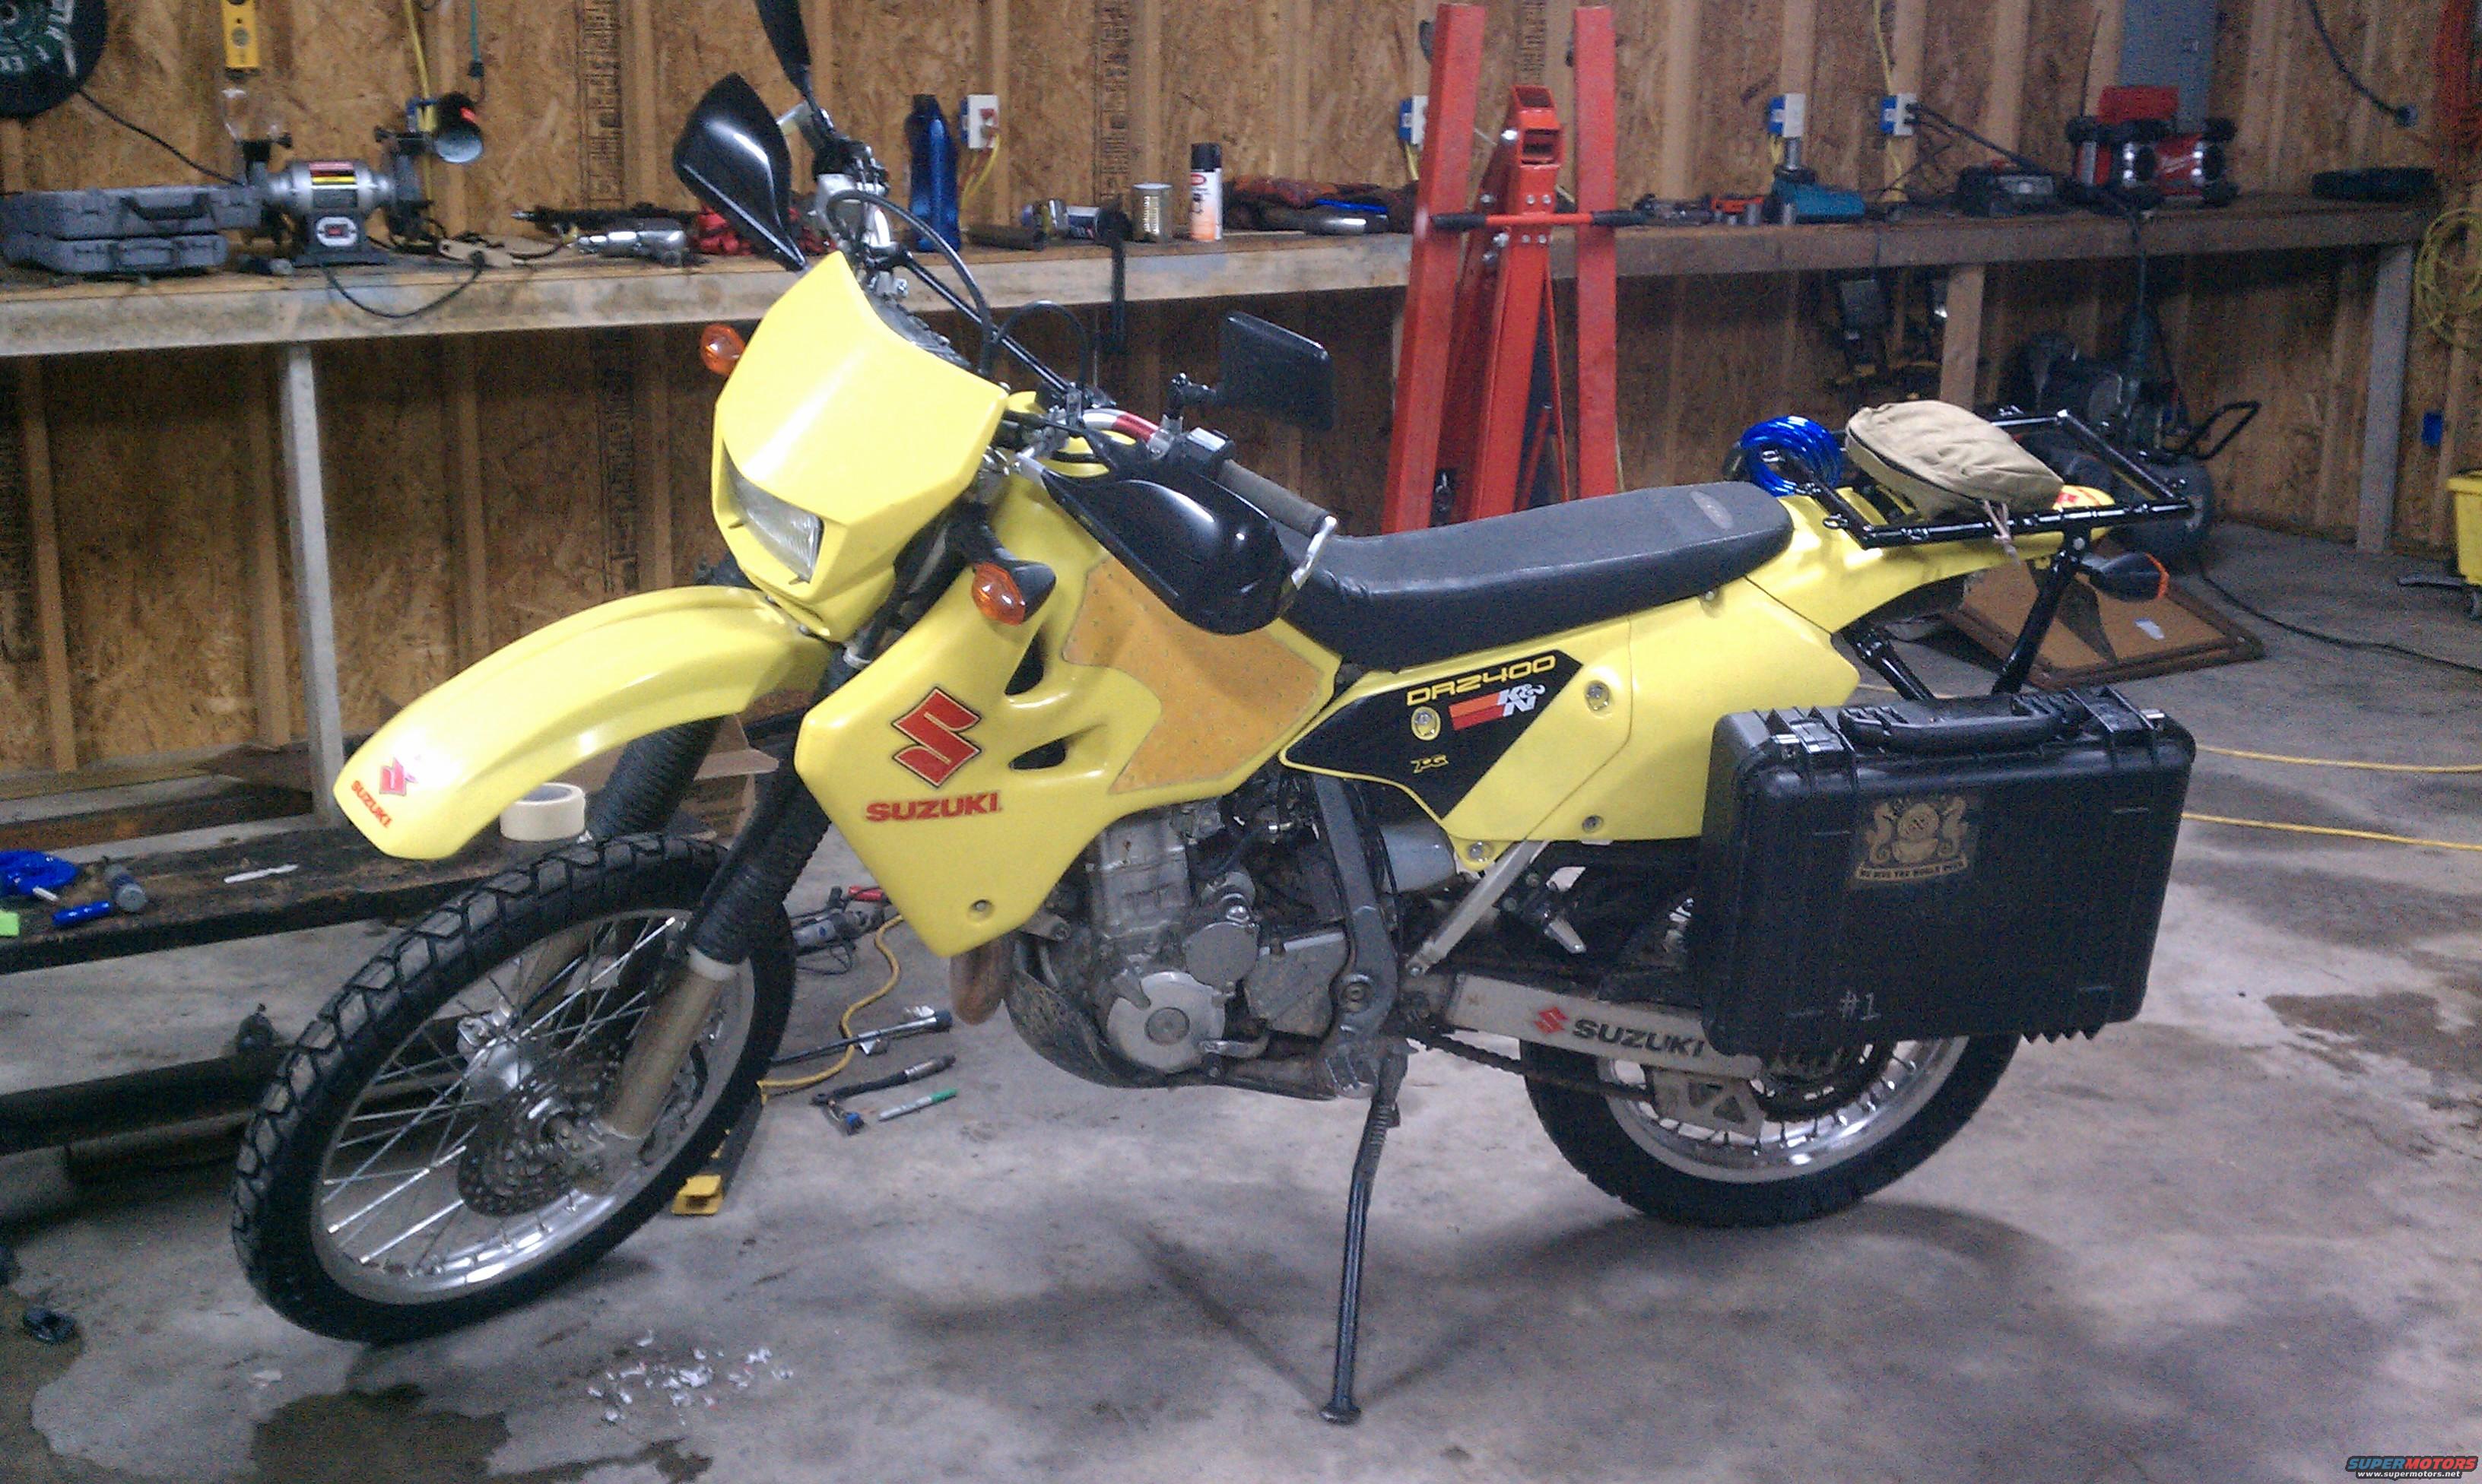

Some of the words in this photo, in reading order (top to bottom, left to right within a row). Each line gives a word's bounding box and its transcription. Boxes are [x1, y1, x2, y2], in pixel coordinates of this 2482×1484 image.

[351, 780, 392, 828] SUZUKI
[865, 792, 999, 822] SUZUKI
[1573, 1018, 1705, 1057] SUZUKI
